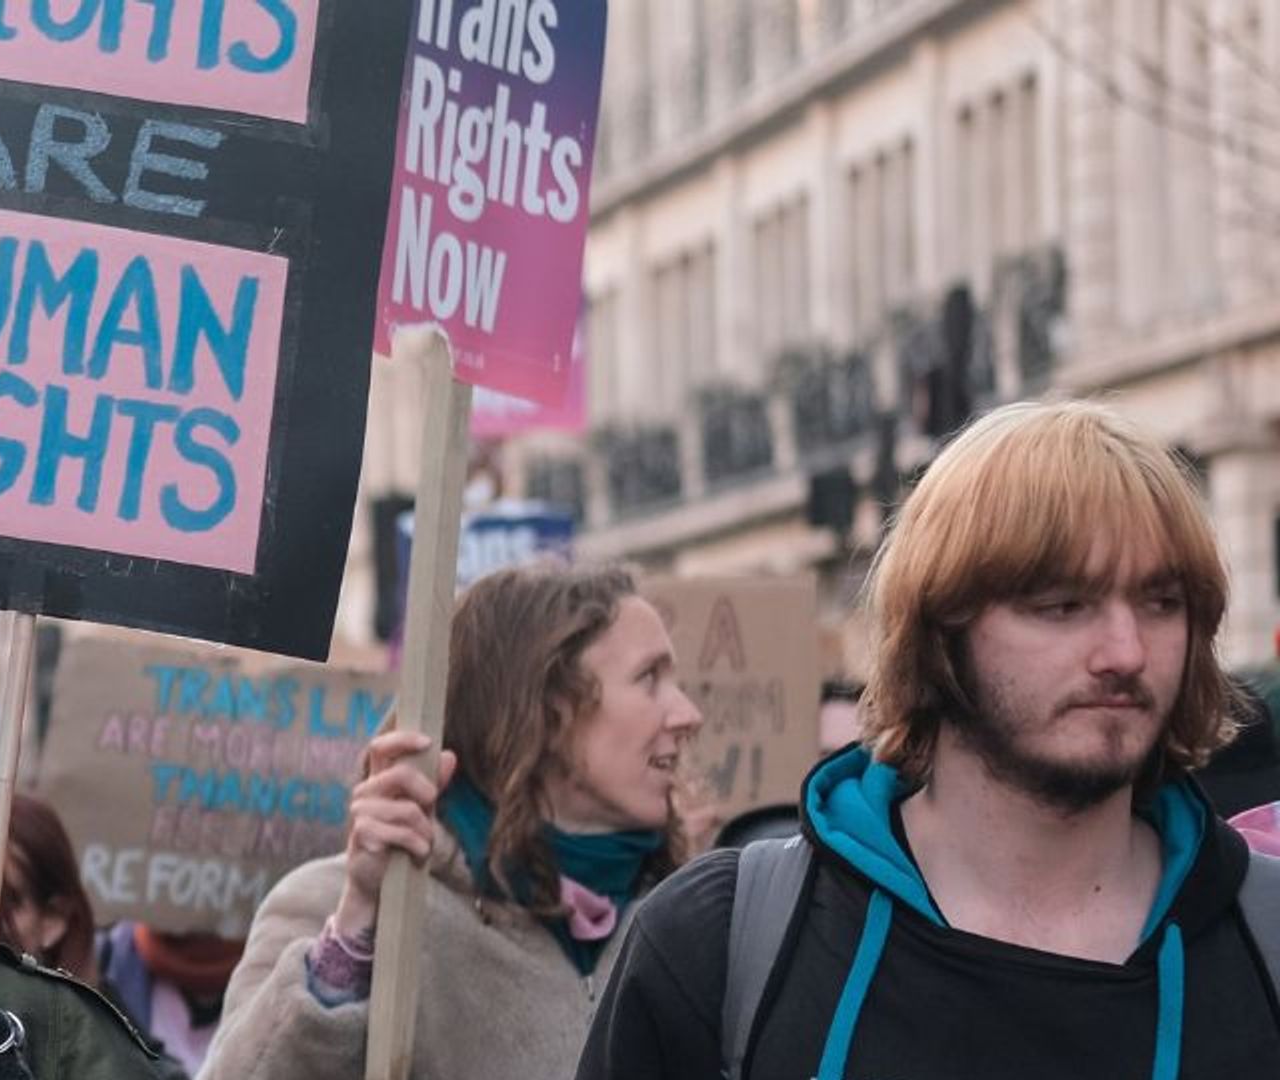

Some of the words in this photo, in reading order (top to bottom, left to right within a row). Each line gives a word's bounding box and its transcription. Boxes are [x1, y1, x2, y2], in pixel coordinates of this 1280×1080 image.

[404, 55, 582, 223] Rights
[392, 185, 507, 334] Now
[143, 664, 299, 731] TRANS
[308, 686, 395, 737] LIV
